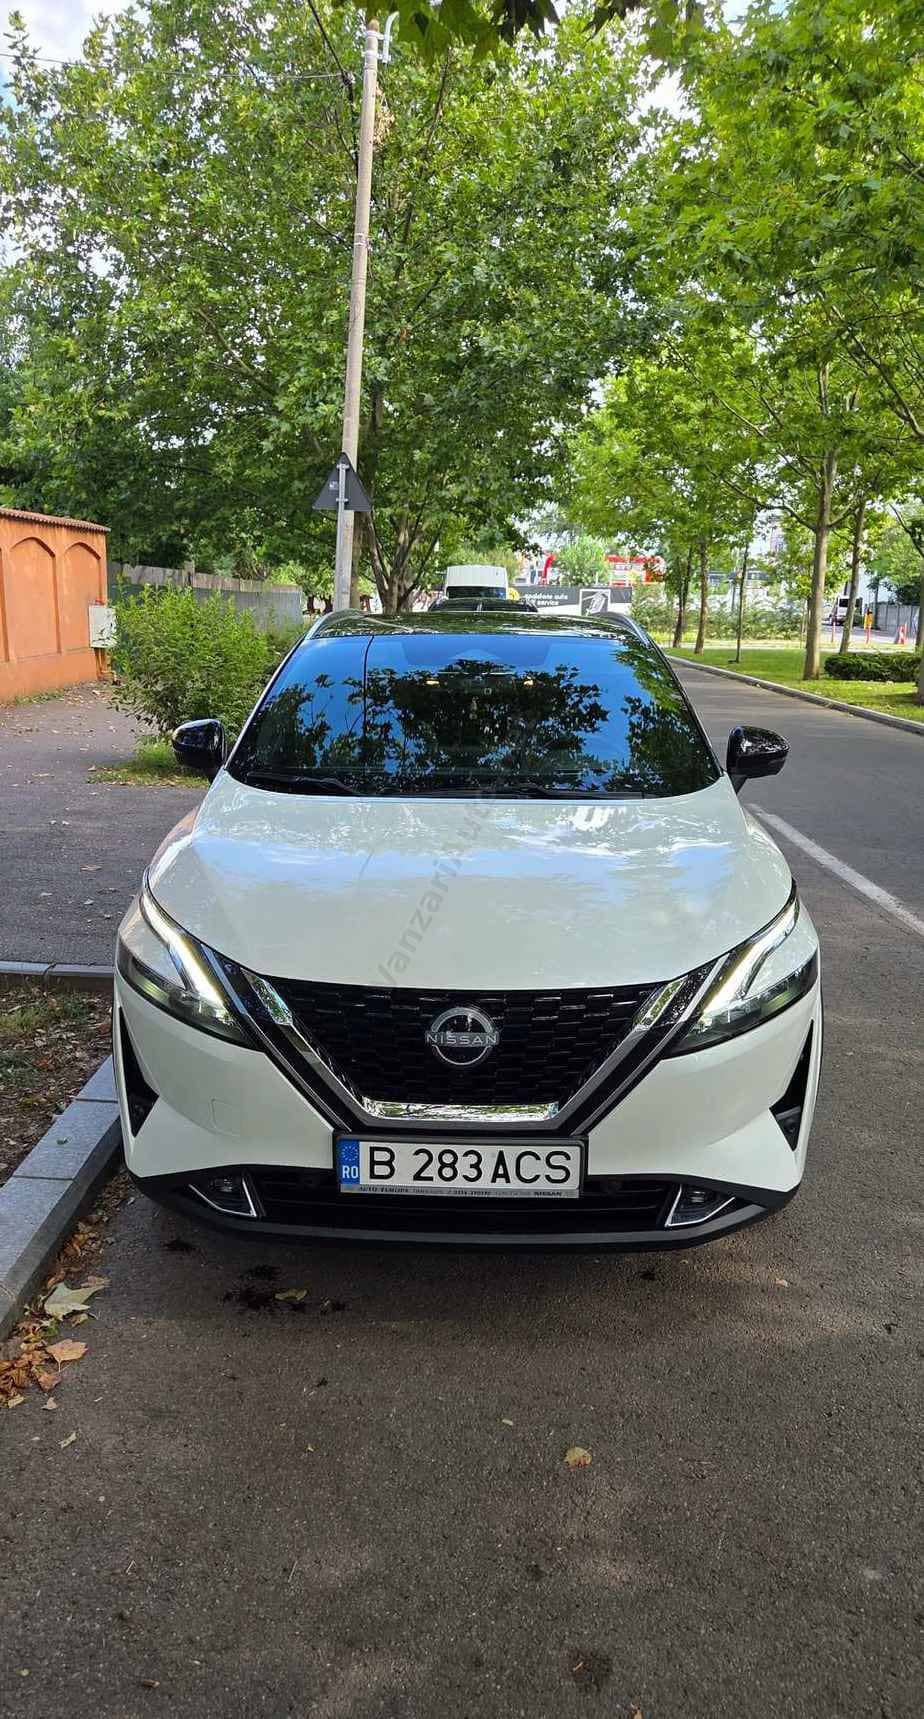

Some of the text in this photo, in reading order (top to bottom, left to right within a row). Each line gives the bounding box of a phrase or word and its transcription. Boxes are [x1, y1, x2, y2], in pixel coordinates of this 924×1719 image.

[426, 1033, 497, 1045] NISSAN
[342, 1165, 359, 1179] RO
[368, 1146, 572, 1184] B 283 ACS
